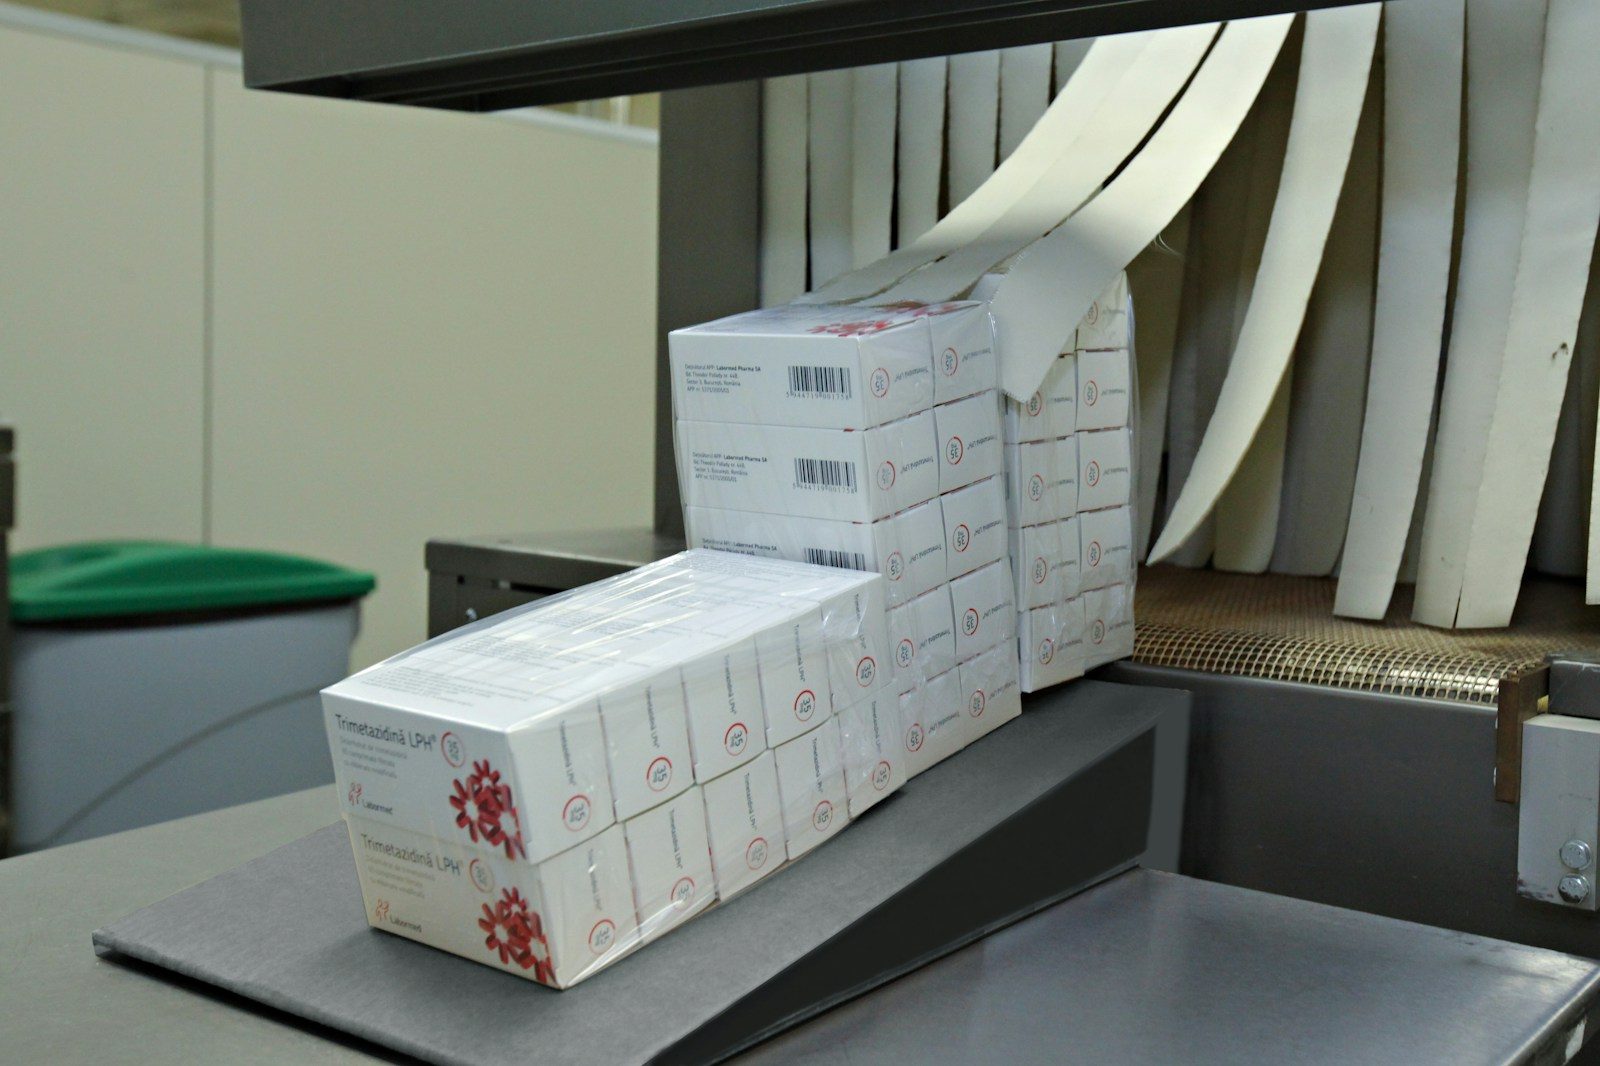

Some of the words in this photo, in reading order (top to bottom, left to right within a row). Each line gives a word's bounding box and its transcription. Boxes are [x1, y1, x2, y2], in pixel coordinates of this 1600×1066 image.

[716, 364, 737, 372] Labormed
[738, 365, 754, 373] Pharma
[335, 713, 406, 746] Trimetazidină
[360, 833, 433, 868] Trimetazidină
